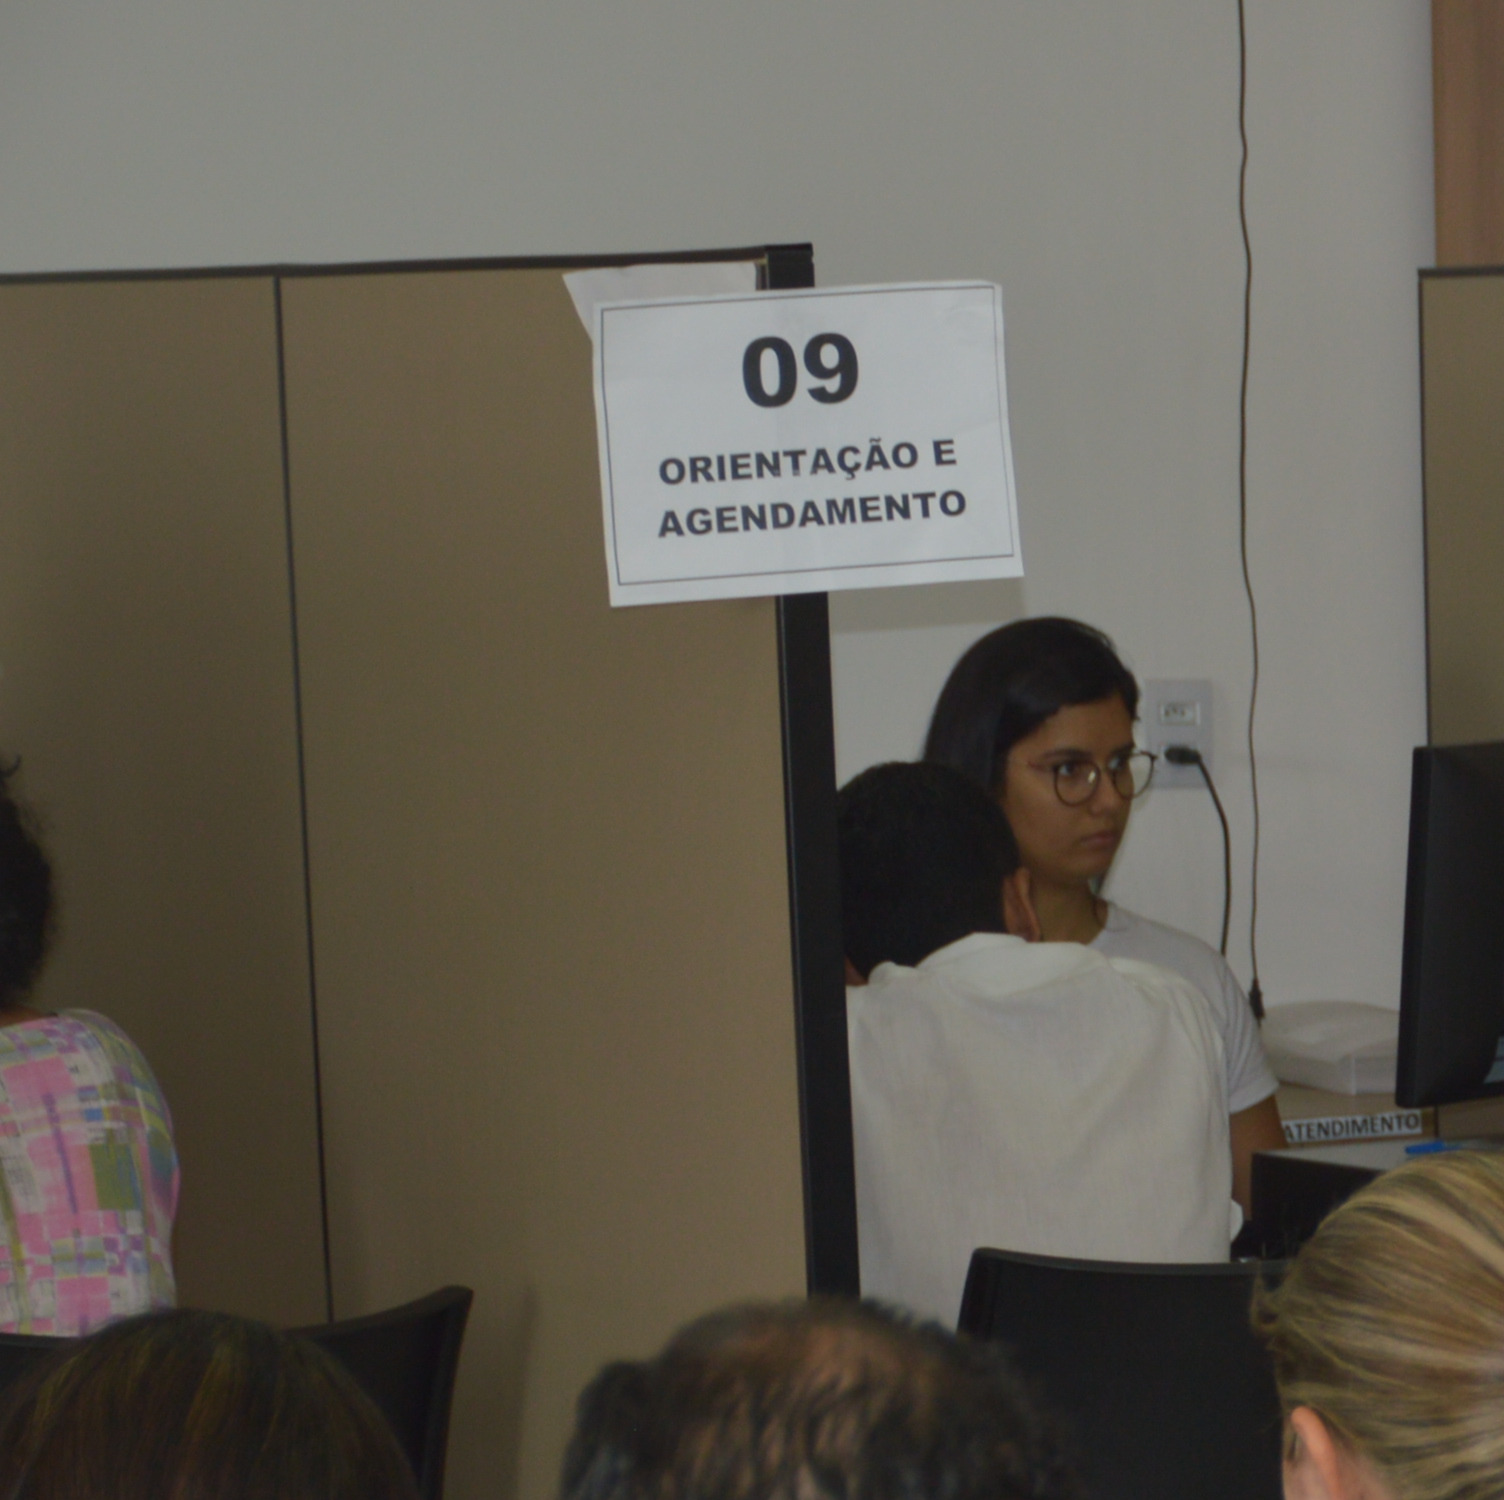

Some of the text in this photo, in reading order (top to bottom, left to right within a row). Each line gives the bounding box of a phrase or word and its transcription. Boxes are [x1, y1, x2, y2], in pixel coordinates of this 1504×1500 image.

[742, 332, 858, 408] 09
[658, 437, 957, 486] ORIENTAÇÃO E
[657, 489, 967, 538] AGENDAMENTO
[1284, 1113, 1420, 1141] ATENDIMENTO
